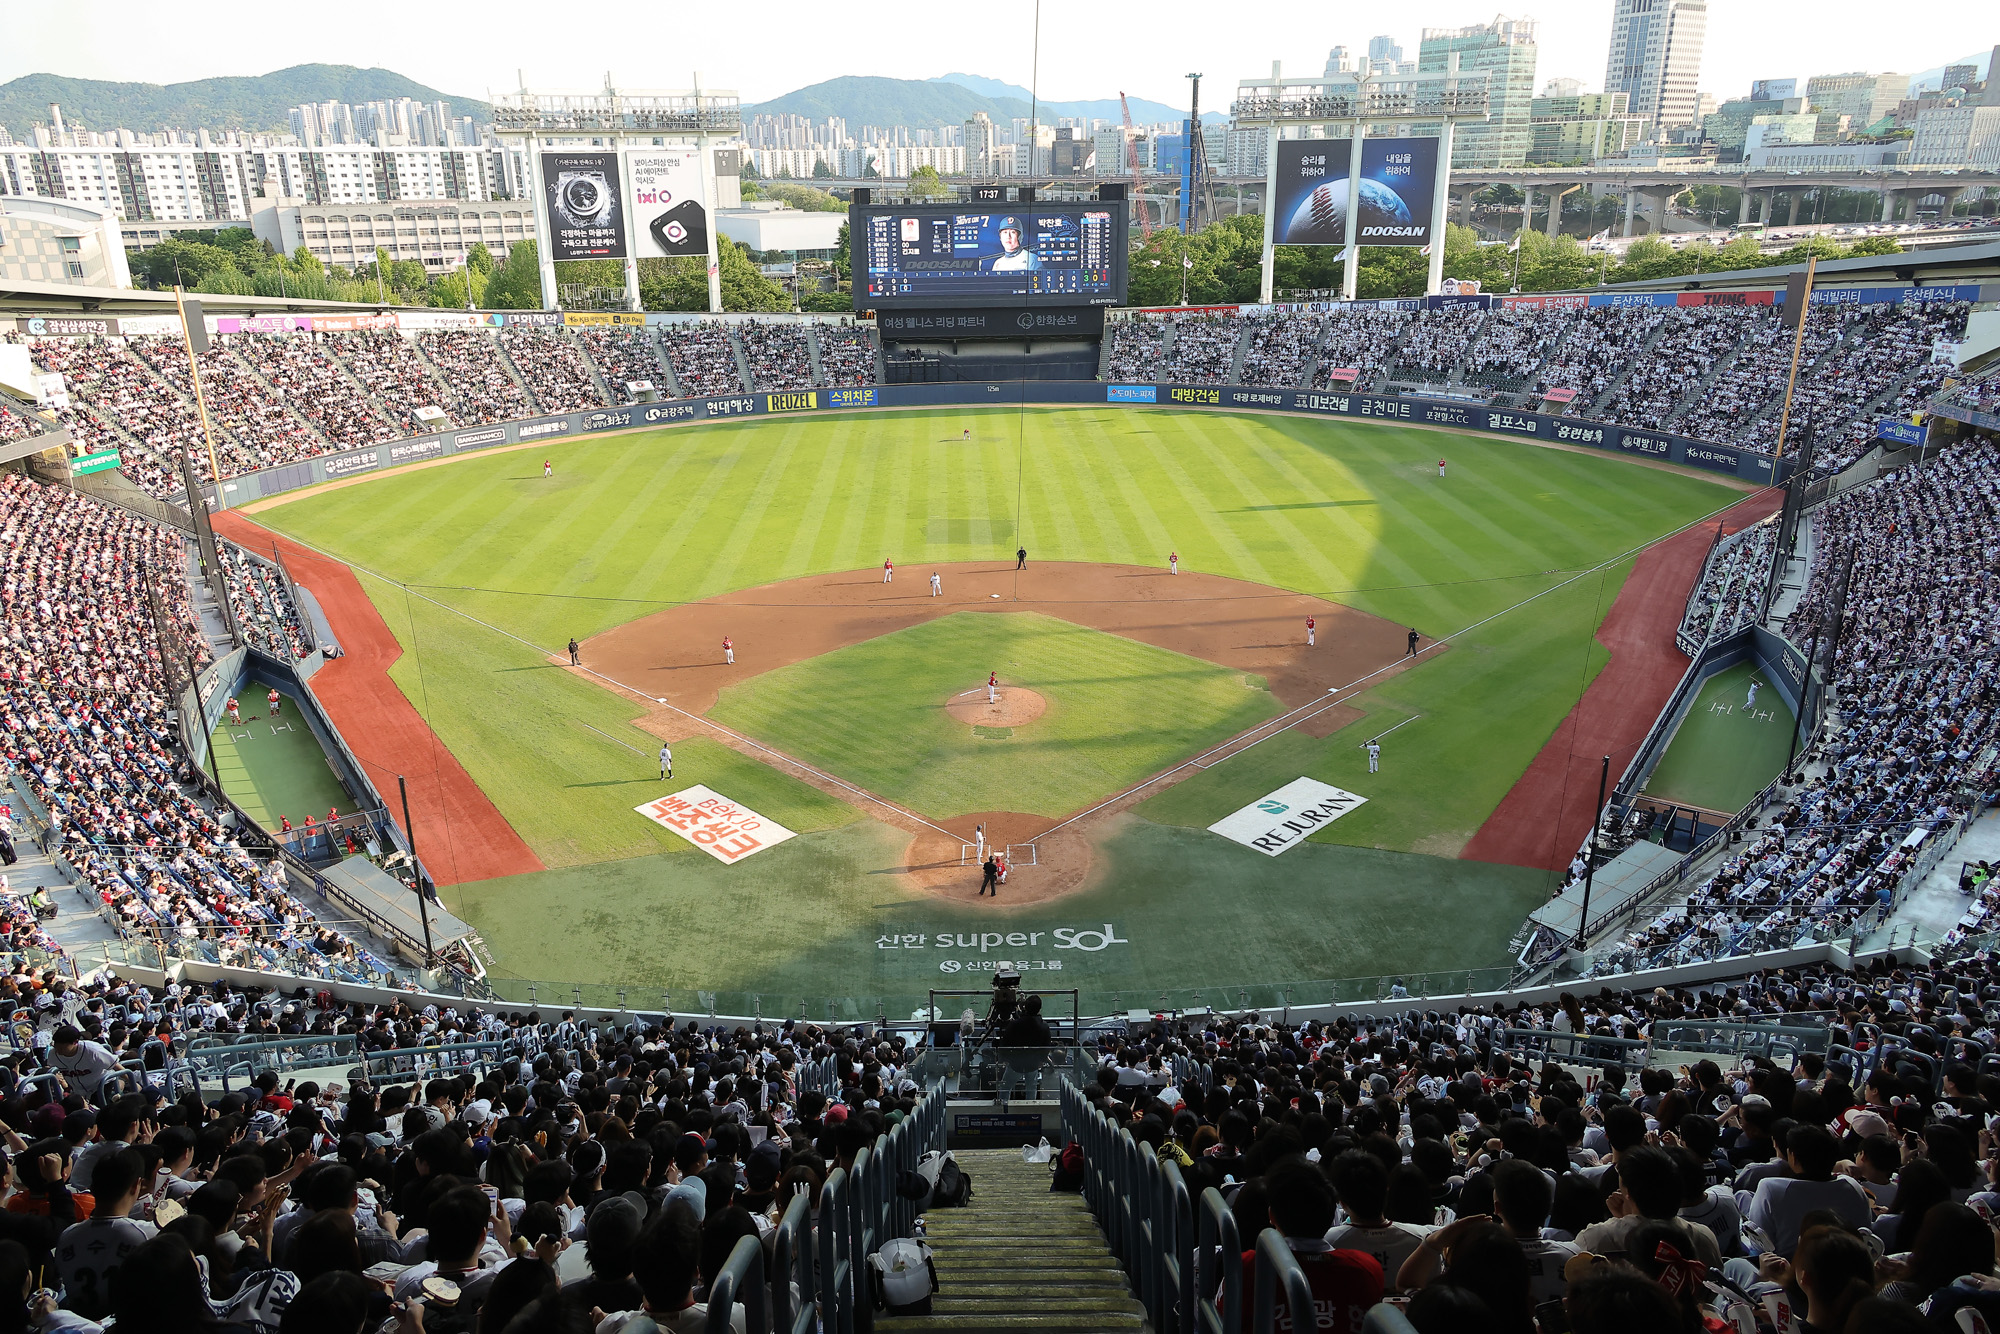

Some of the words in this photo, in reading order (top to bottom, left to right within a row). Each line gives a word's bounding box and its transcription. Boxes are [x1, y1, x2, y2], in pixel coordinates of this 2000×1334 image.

[634, 159, 667, 167] 보이스피싱
[667, 158, 680, 167] 안심
[1301, 155, 1326, 166] 승리를
[1385, 153, 1412, 164] 내일을
[644, 167, 670, 175] 에이전트
[1300, 167, 1326, 177] 위하여
[1385, 166, 1411, 176] 위하여
[635, 176, 656, 184] 익시오
[978, 189, 999, 199] 17:37
[980, 215, 990, 227] 7
[1038, 218, 1063, 228] 박찬호
[560, 229, 588, 238] 걱정하는
[589, 228, 616, 237] 마음까지
[1361, 226, 1426, 237] DOOSAN
[561, 239, 589, 248] 구독으로
[905, 260, 975, 270] DOOSAN
[1083, 274, 1089, 282] 3
[1092, 274, 1099, 282] 0
[1703, 293, 1747, 305] TVING
[1809, 290, 1862, 303] 에너빌리티
[1902, 287, 1957, 301] 두산테스나
[1467, 301, 1480, 311] ON
[1515, 301, 1540, 309] Bobcat
[1544, 296, 1585, 310] 두산밥캣
[1612, 294, 1655, 308] 두산전자
[238, 318, 284, 333] 몽베스트
[508, 313, 558, 326] 대화제약
[884, 318, 904, 329] 여성
[905, 317, 934, 328] 웰니스
[936, 316, 955, 327] 리딩
[957, 316, 986, 327] 파트너
[1035, 315, 1078, 326] 한화손보
[49, 320, 109, 334] 잠실삼성안과
[831, 389, 874, 402] 스위치온
[1117, 389, 1155, 399] 도미노피자
[1171, 388, 1220, 403] 대방건설
[1233, 392, 1249, 402] 대광
[1250, 393, 1282, 405] 로제비앙
[706, 398, 754, 415] 현대해상
[771, 393, 812, 411] REUZEL
[1309, 394, 1350, 412] 대보건설
[1361, 399, 1411, 417] 금천미트
[660, 405, 694, 418] 금강주택
[1425, 411, 1470, 424] 포천힐스CC
[519, 422, 560, 437] 세신버팔로
[457, 432, 480, 444] BANDAI
[480, 431, 503, 441] NAMCO
[390, 440, 441, 457] 한국수력원자력
[335, 451, 377, 468] 유안타증권
[1699, 450, 1713, 460] KB
[1712, 453, 1738, 466] 국민카드
[651, 796, 763, 860] 백조씽크
[1251, 794, 1356, 852] REJURAN
[874, 933, 927, 950] 신한
[934, 931, 1046, 953] super
[1052, 923, 1129, 952] SOL
[965, 960, 1064, 971] 신한융그룹
